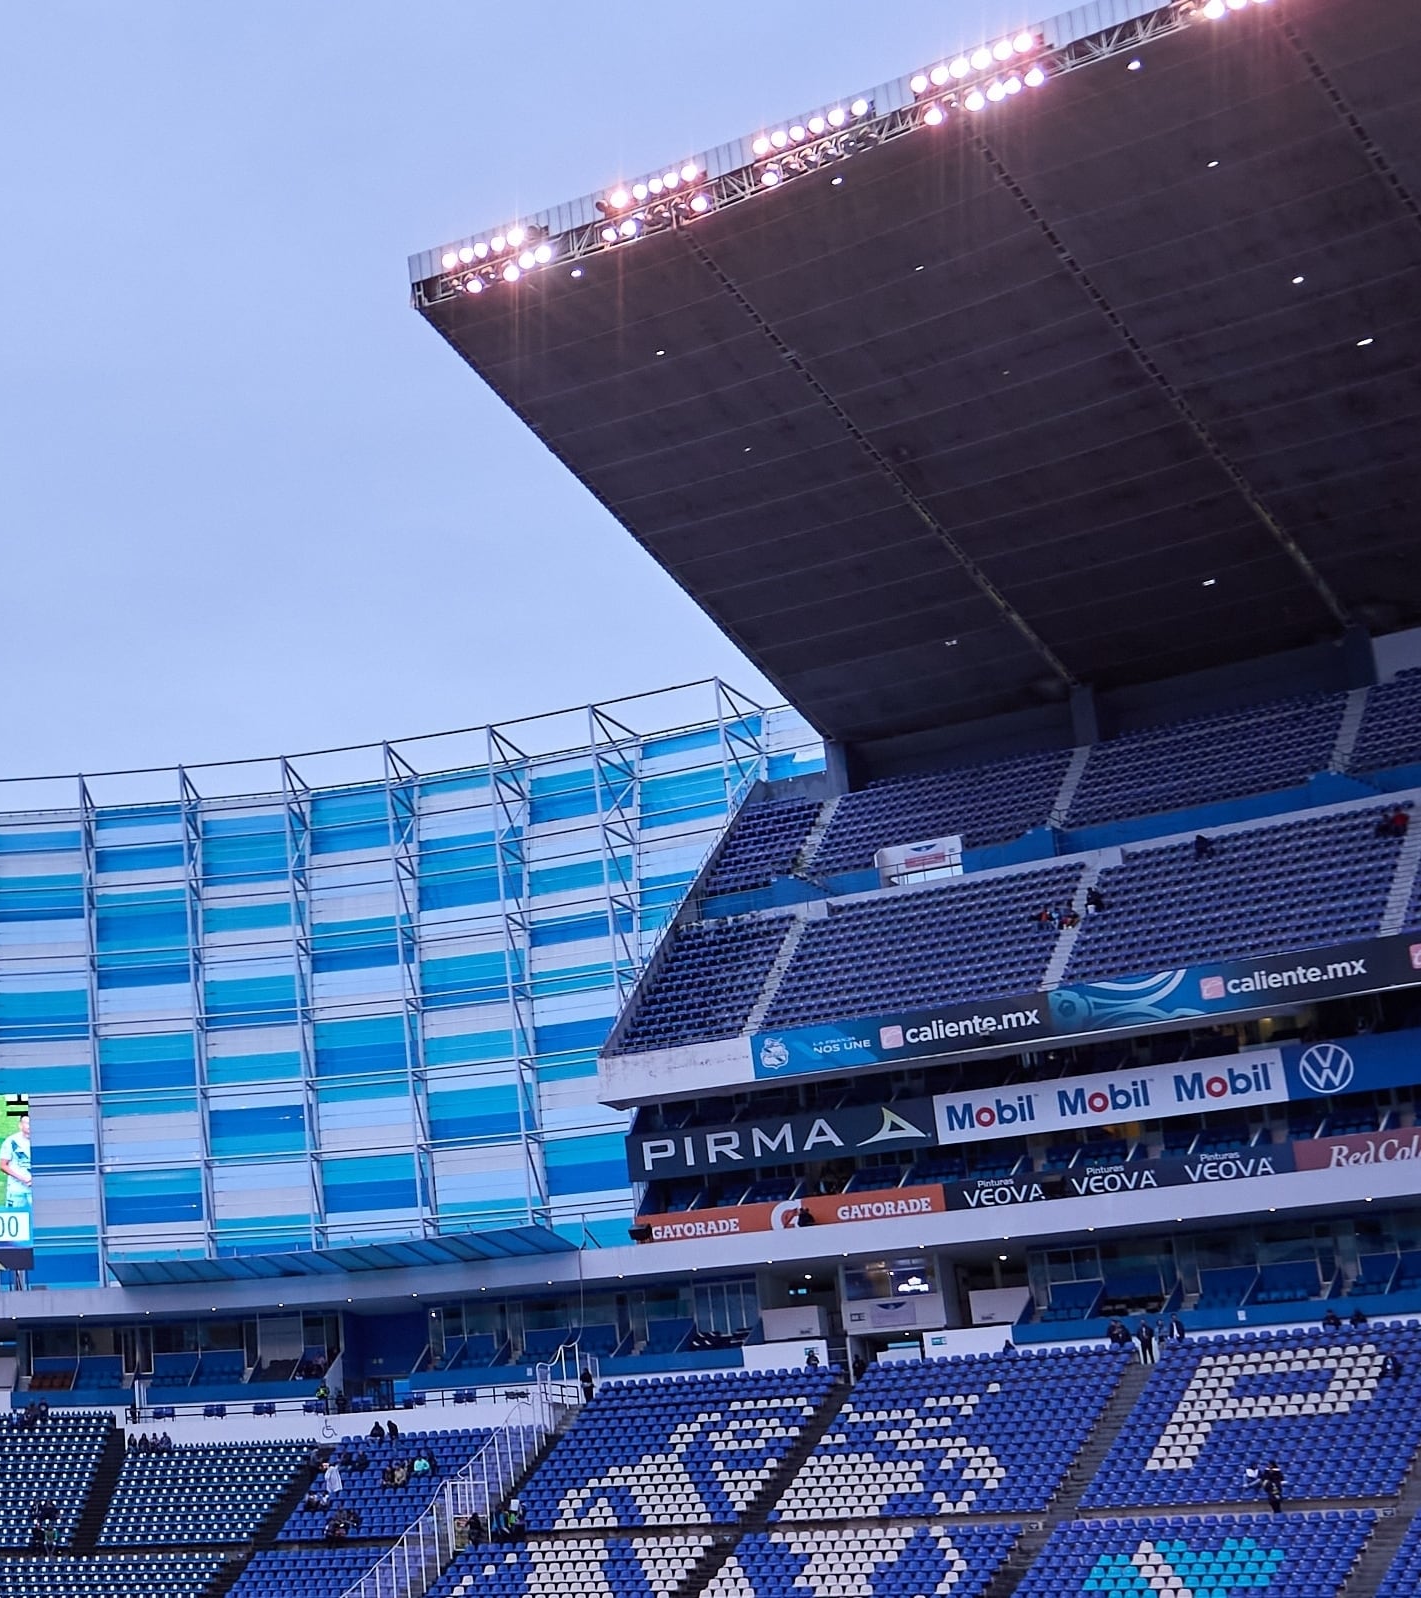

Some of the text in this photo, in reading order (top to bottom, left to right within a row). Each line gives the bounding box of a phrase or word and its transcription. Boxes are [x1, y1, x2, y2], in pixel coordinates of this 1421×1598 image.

[1226, 959, 1367, 995] caliente.mx
[905, 1009, 1040, 1043] caliente.mx
[813, 1039, 871, 1054] NOS UNE
[1173, 1062, 1272, 1102] Mobil
[1057, 1078, 1150, 1118] Mobil
[946, 1094, 1035, 1131] Mobil
[642, 1118, 845, 1171] PIRMA
[1200, 1151, 1241, 1163] Pinturas
[1329, 1135, 1421, 1168] Red Col
[1071, 1170, 1158, 1195] VEOVA
[1086, 1164, 1125, 1176] Pinturas
[1184, 1157, 1276, 1183] VEOVA
[963, 1183, 1046, 1208] VEOVA
[977, 1178, 1014, 1188] Pinturas
[837, 1198, 932, 1220] GATORADE
[652, 1218, 740, 1240] GATORADE
